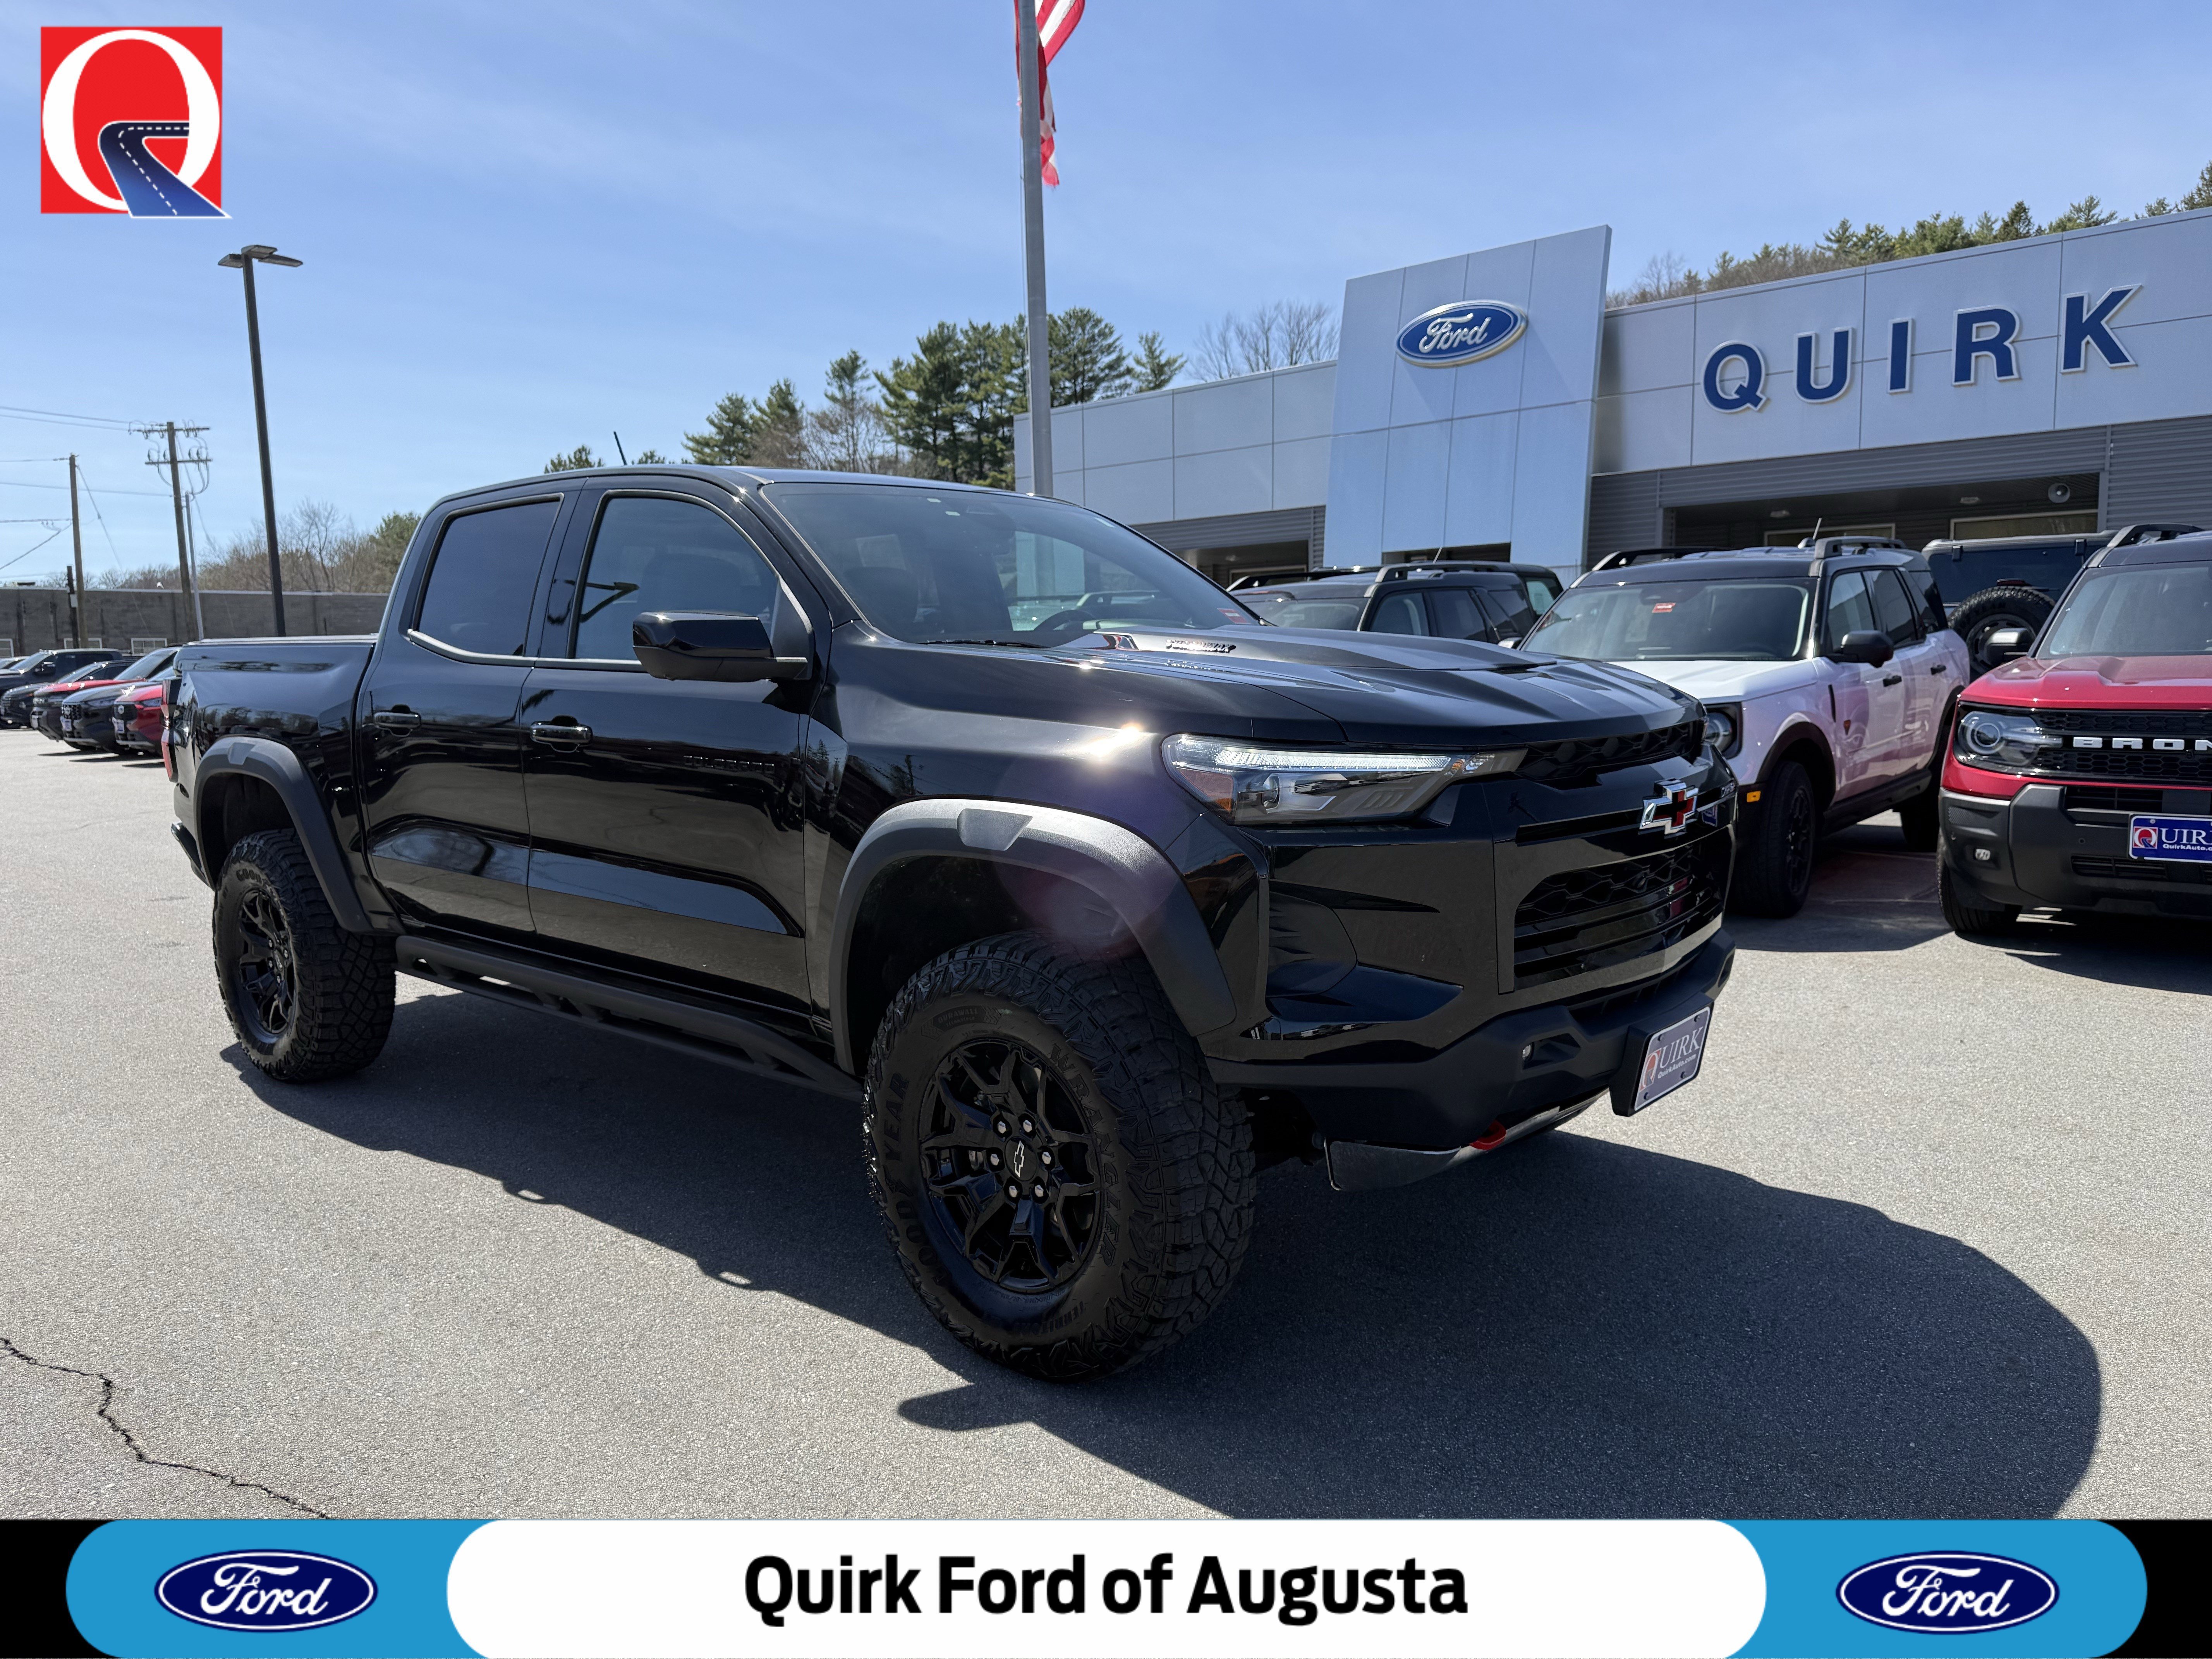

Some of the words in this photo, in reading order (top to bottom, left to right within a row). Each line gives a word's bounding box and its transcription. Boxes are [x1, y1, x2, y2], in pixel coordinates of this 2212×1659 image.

[1419, 313, 1492, 353] Ford
[1702, 283, 2142, 413] QUIRK
[2134, 827, 2212, 849] QUIR
[1642, 1026, 1704, 1088] QUIRK
[1050, 1044, 1120, 1267] WRANGLER
